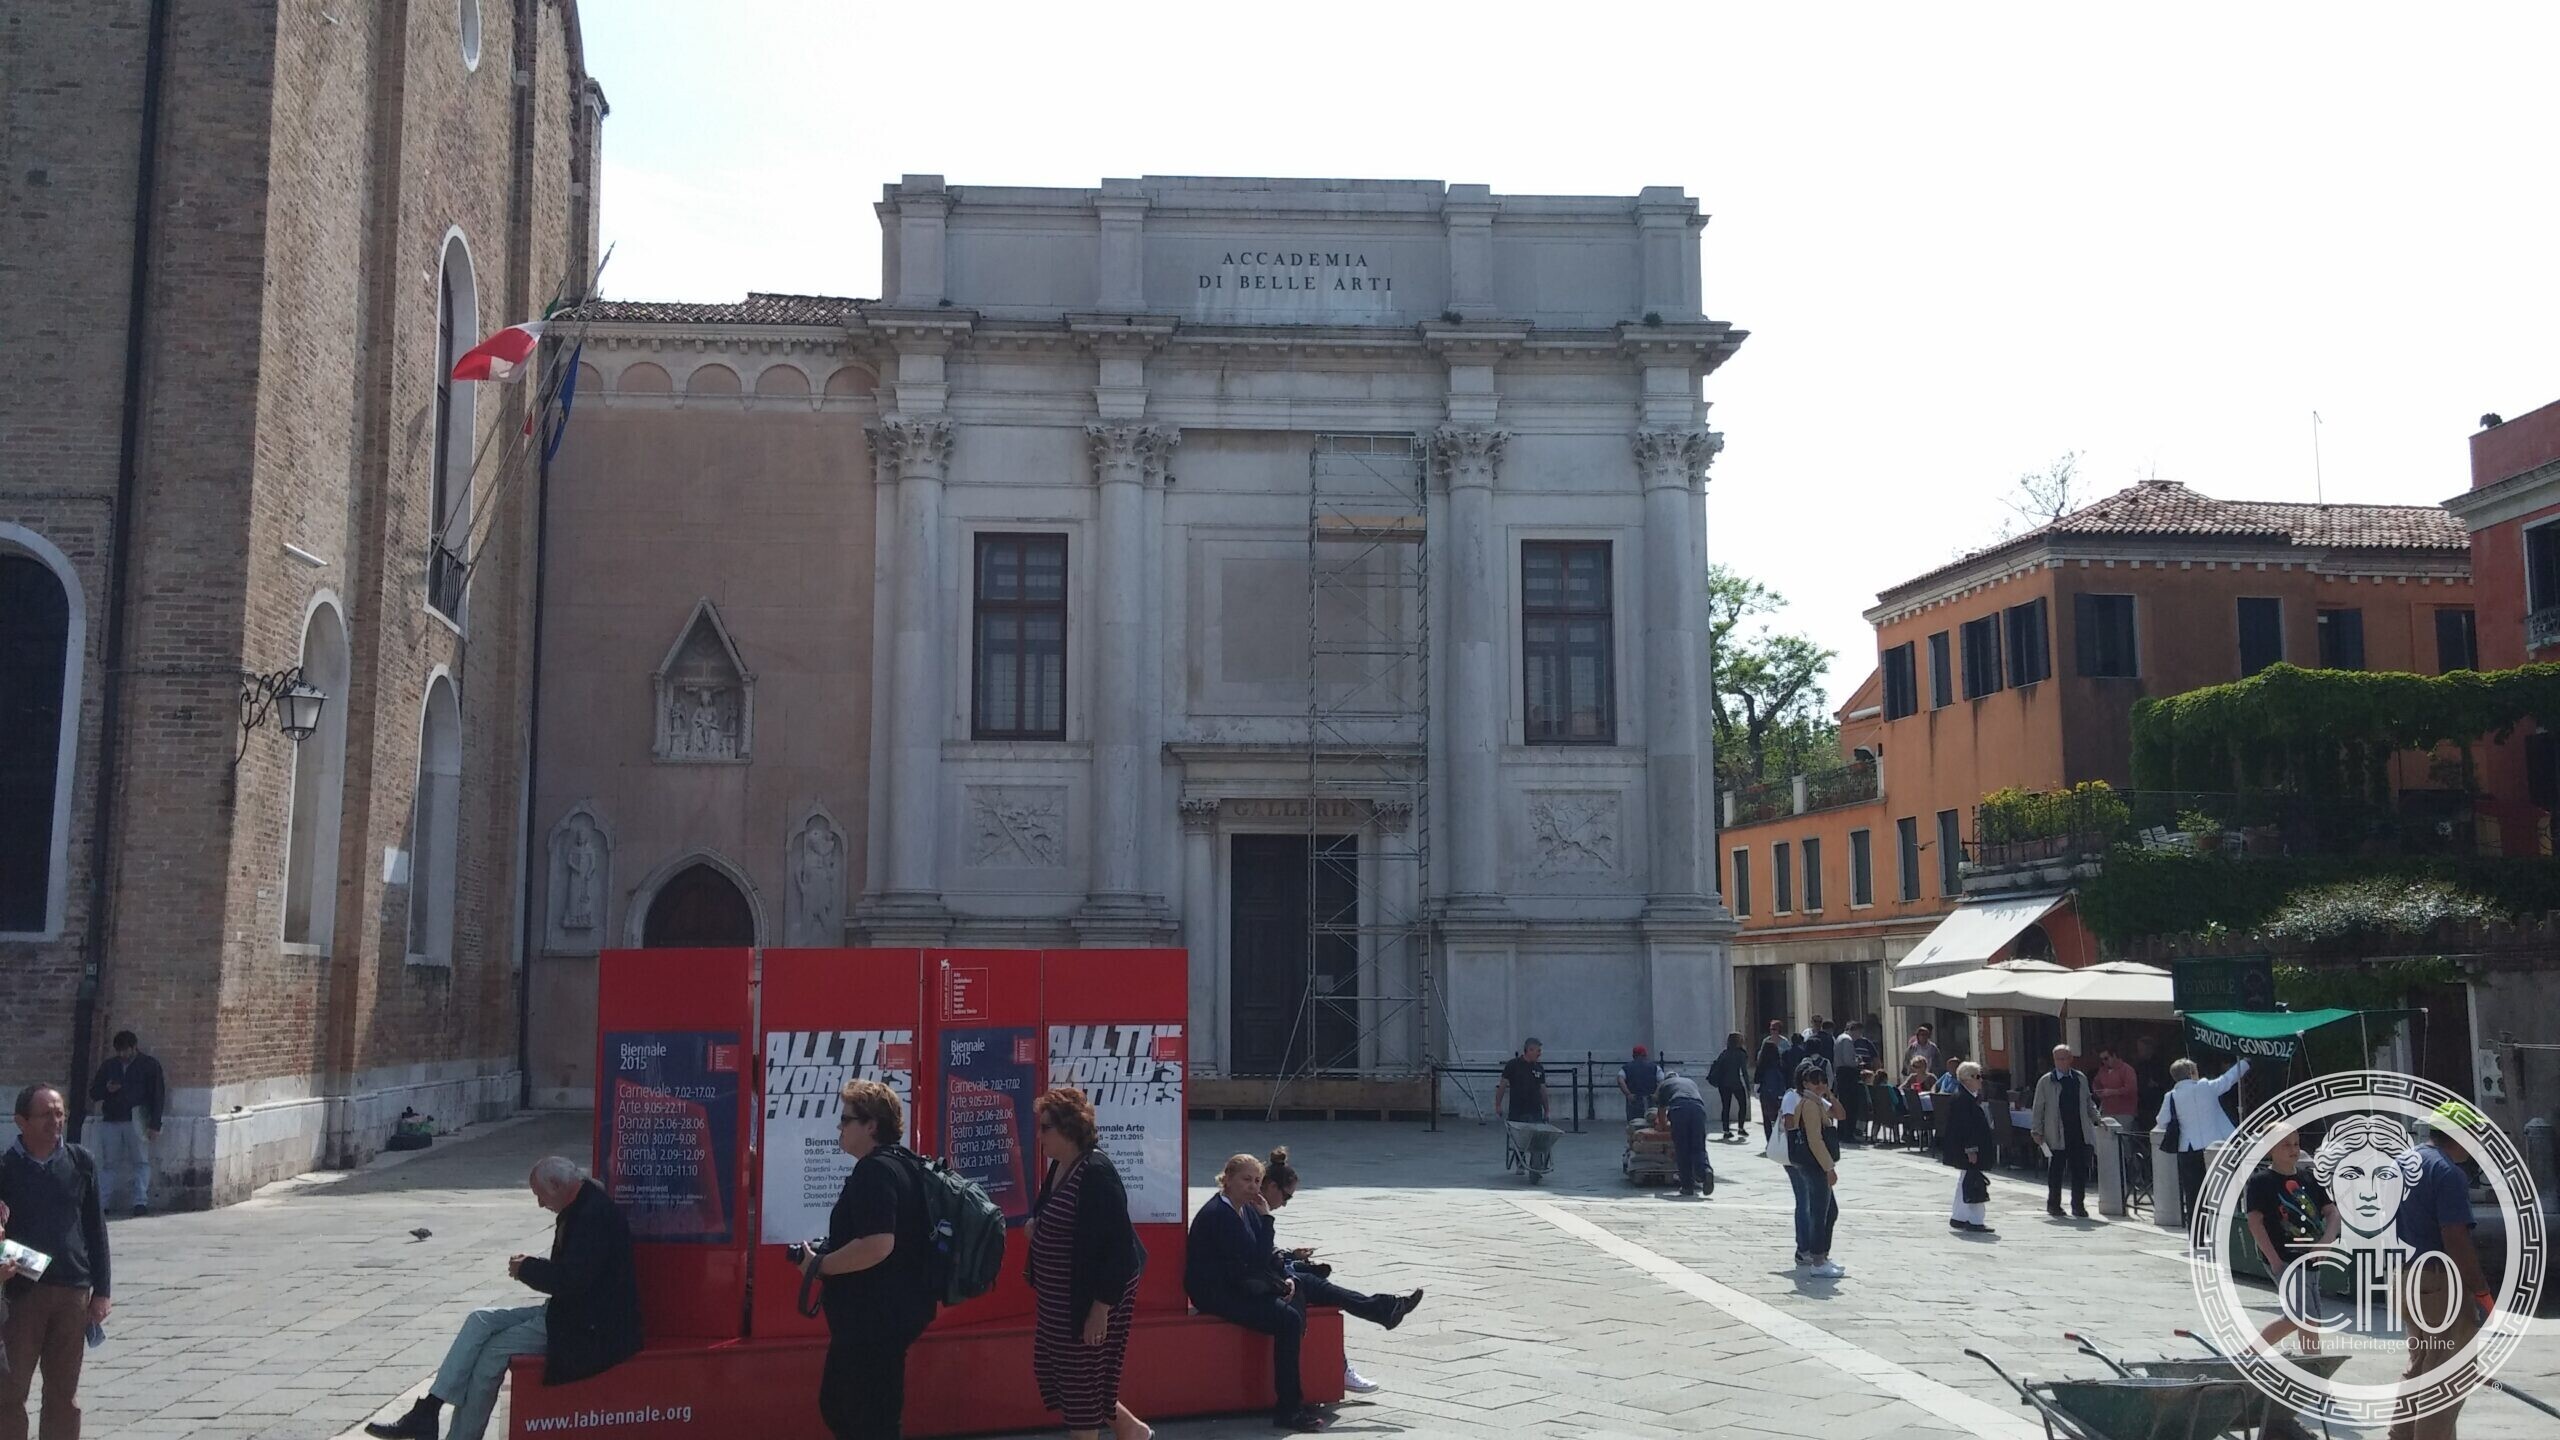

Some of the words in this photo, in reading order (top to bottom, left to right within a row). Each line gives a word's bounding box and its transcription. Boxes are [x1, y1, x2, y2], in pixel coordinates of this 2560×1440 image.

[1222, 252, 1368, 267] ACCADEMIA
[1199, 275, 1222, 289] DI
[1240, 276, 1315, 290] BELLE
[1334, 277, 1392, 291] ARTI
[1233, 800, 1355, 817] GALLERIE
[620, 1041, 667, 1057] Biennale
[950, 1038, 986, 1052] Biennale
[2194, 1026, 2232, 1051] SRVIZIO
[2238, 1037, 2295, 1058] GONDOLE
[620, 1056, 648, 1070] 2015
[950, 1052, 971, 1066] 2015
[1048, 1057, 1182, 1083] WORLD'S
[619, 1083, 672, 1098] Carnevale
[950, 1077, 989, 1093] Carnevale
[618, 1100, 641, 1114] Arte
[950, 1096, 967, 1109] Arte
[618, 1115, 652, 1129] Danza
[949, 1110, 974, 1124] Danza
[950, 1125, 974, 1139] Teatro
[1096, 1124, 1124, 1132] ennale
[1126, 1124, 1145, 1132] Arte
[618, 1130, 650, 1145] Teatro
[805, 1138, 839, 1147] Bienna
[616, 1146, 657, 1160] Cinema
[949, 1140, 979, 1154] Cinema
[615, 1161, 653, 1176] Musica
[950, 1156, 977, 1169] Musica
[525, 1405, 692, 1432] www.labiennale.org
